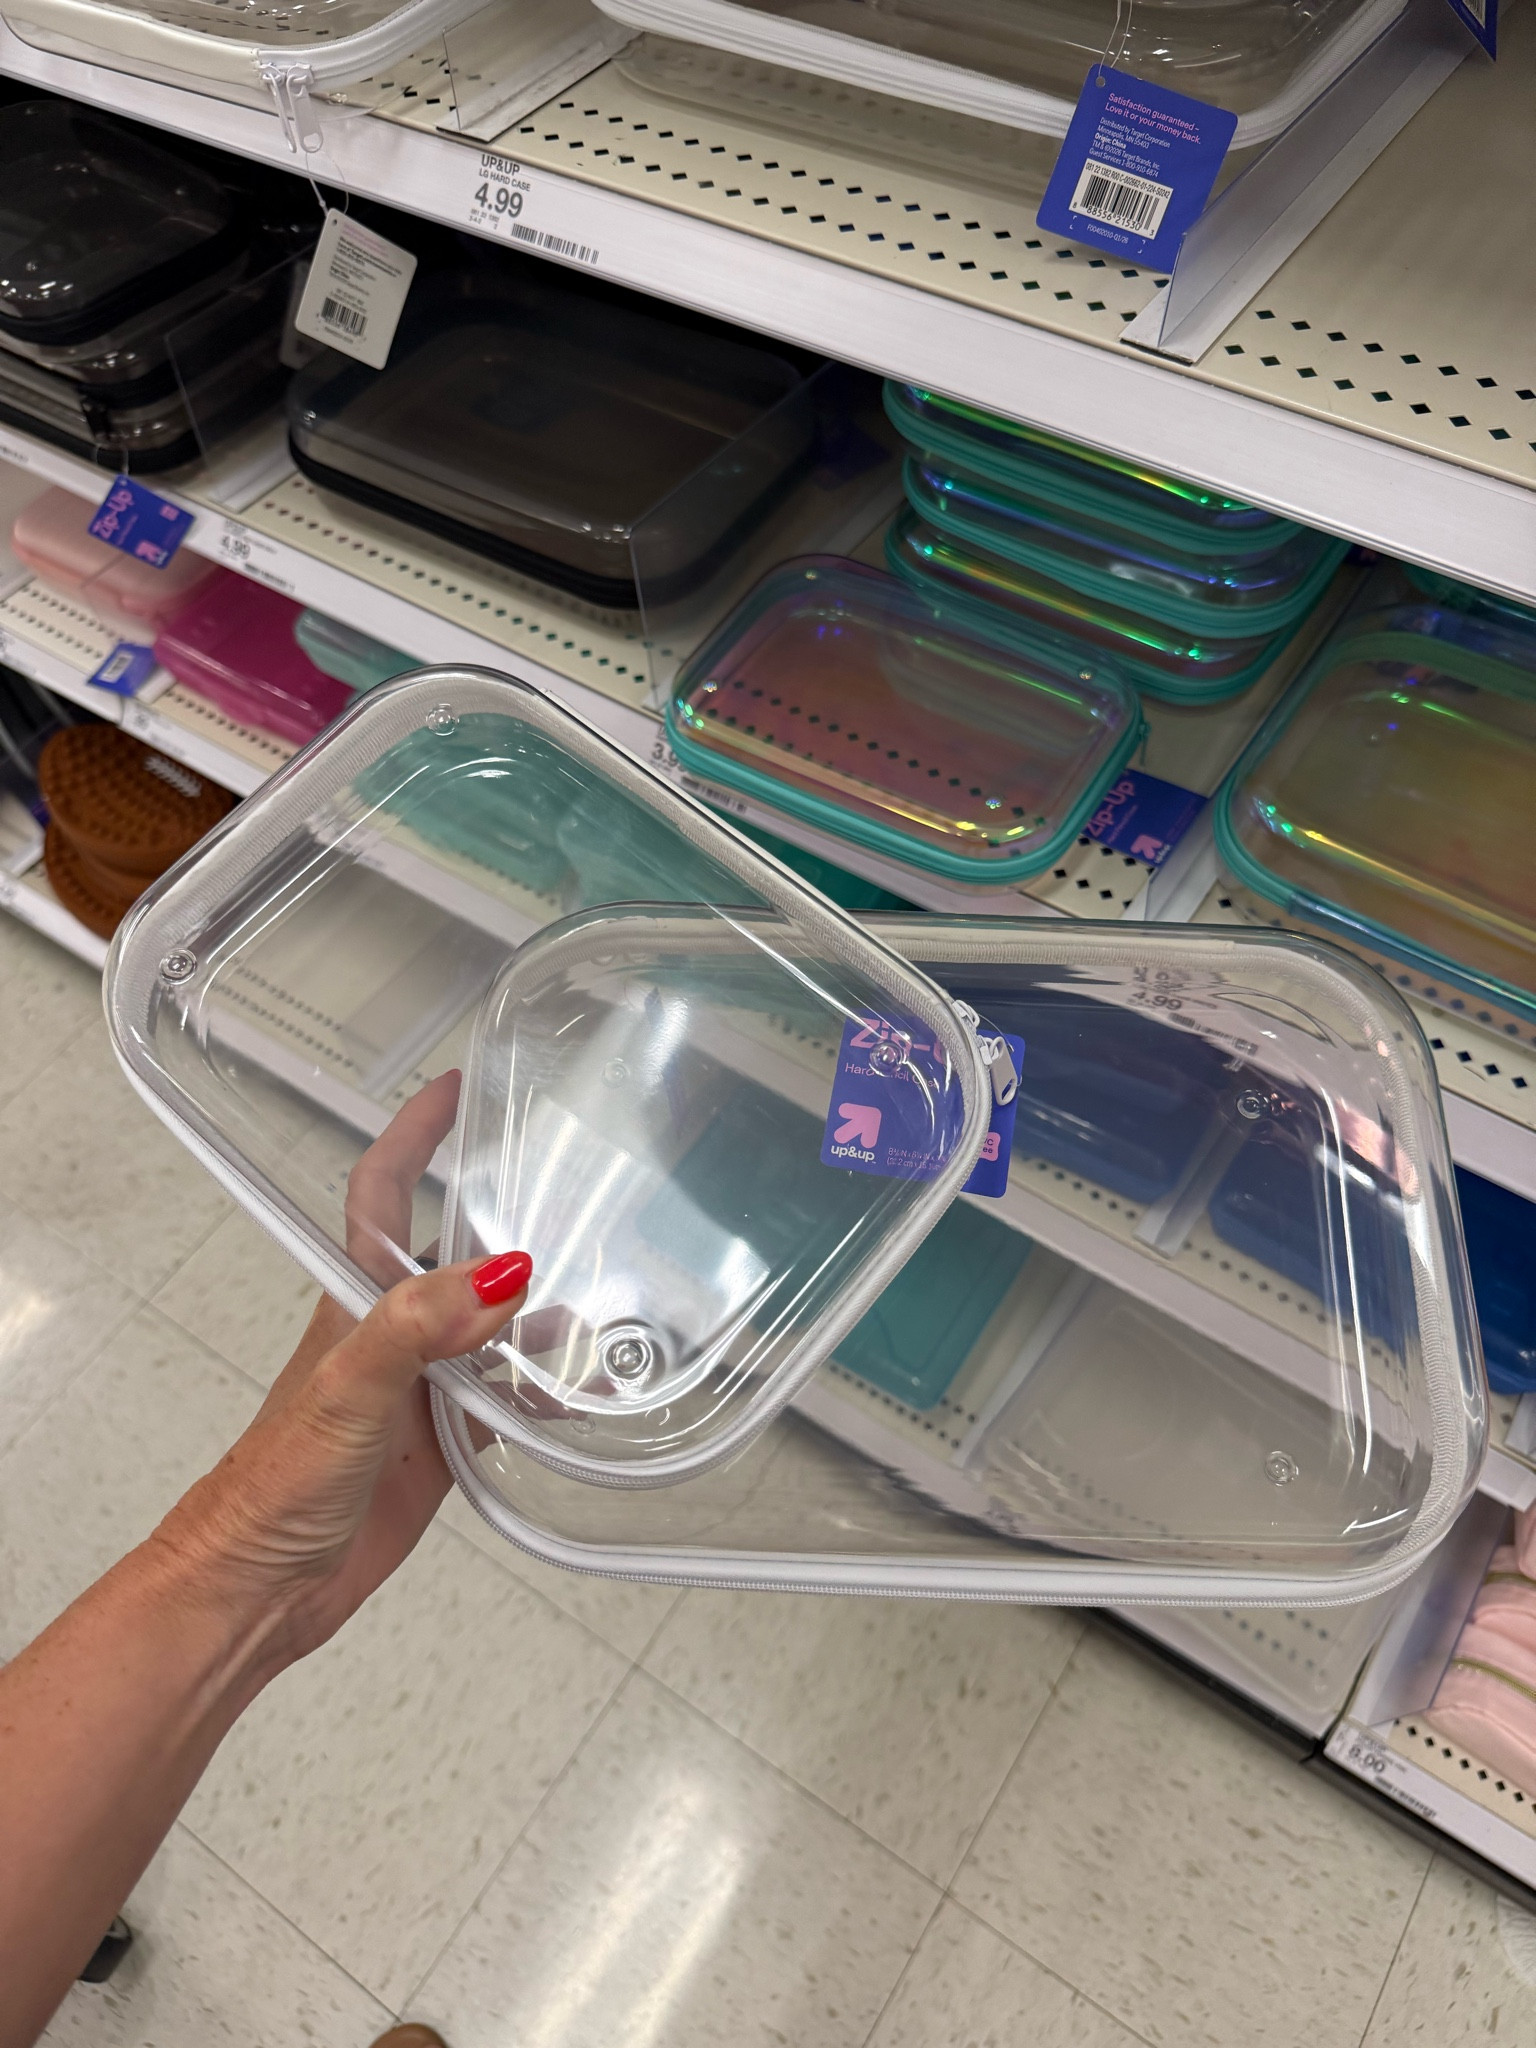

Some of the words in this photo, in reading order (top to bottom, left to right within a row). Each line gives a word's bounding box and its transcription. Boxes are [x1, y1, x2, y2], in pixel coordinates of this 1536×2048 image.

[1105, 102, 1123, 115] Love
[1123, 108, 1129, 118] it
[1129, 112, 1139, 121] or
[1139, 115, 1156, 127] your
[1156, 122, 1181, 138] money
[1182, 130, 1201, 144] back.
[1108, 92, 1152, 115] Satisfaction
[1152, 110, 1195, 131] guaranteed
[1100, 117, 1125, 131] Distributed
[1125, 125, 1131, 134] by
[1131, 126, 1145, 138] Target
[1145, 133, 1170, 148] Corporation
[1111, 138, 1127, 149] China
[1125, 134, 1134, 143] MN
[481, 154, 520, 176] UP&UP
[1085, 162, 1094, 171] 081
[1094, 164, 1101, 173] 22
[1089, 147, 1103, 157] Guest
[1103, 152, 1121, 165] Services
[1122, 150, 1136, 161] Target
[479, 168, 489, 179] LG
[490, 172, 510, 185] HARD
[511, 178, 531, 192] CASE
[474, 182, 523, 218] 4.99
[1086, 206, 1112, 221] 88556
[1115, 215, 1141, 231] 21530
[92, 489, 135, 539] Zip-Up
[652, 742, 688, 772] 3.9
[1086, 781, 1136, 838] Zip-Up
[830, 1145, 876, 1163] up&up
